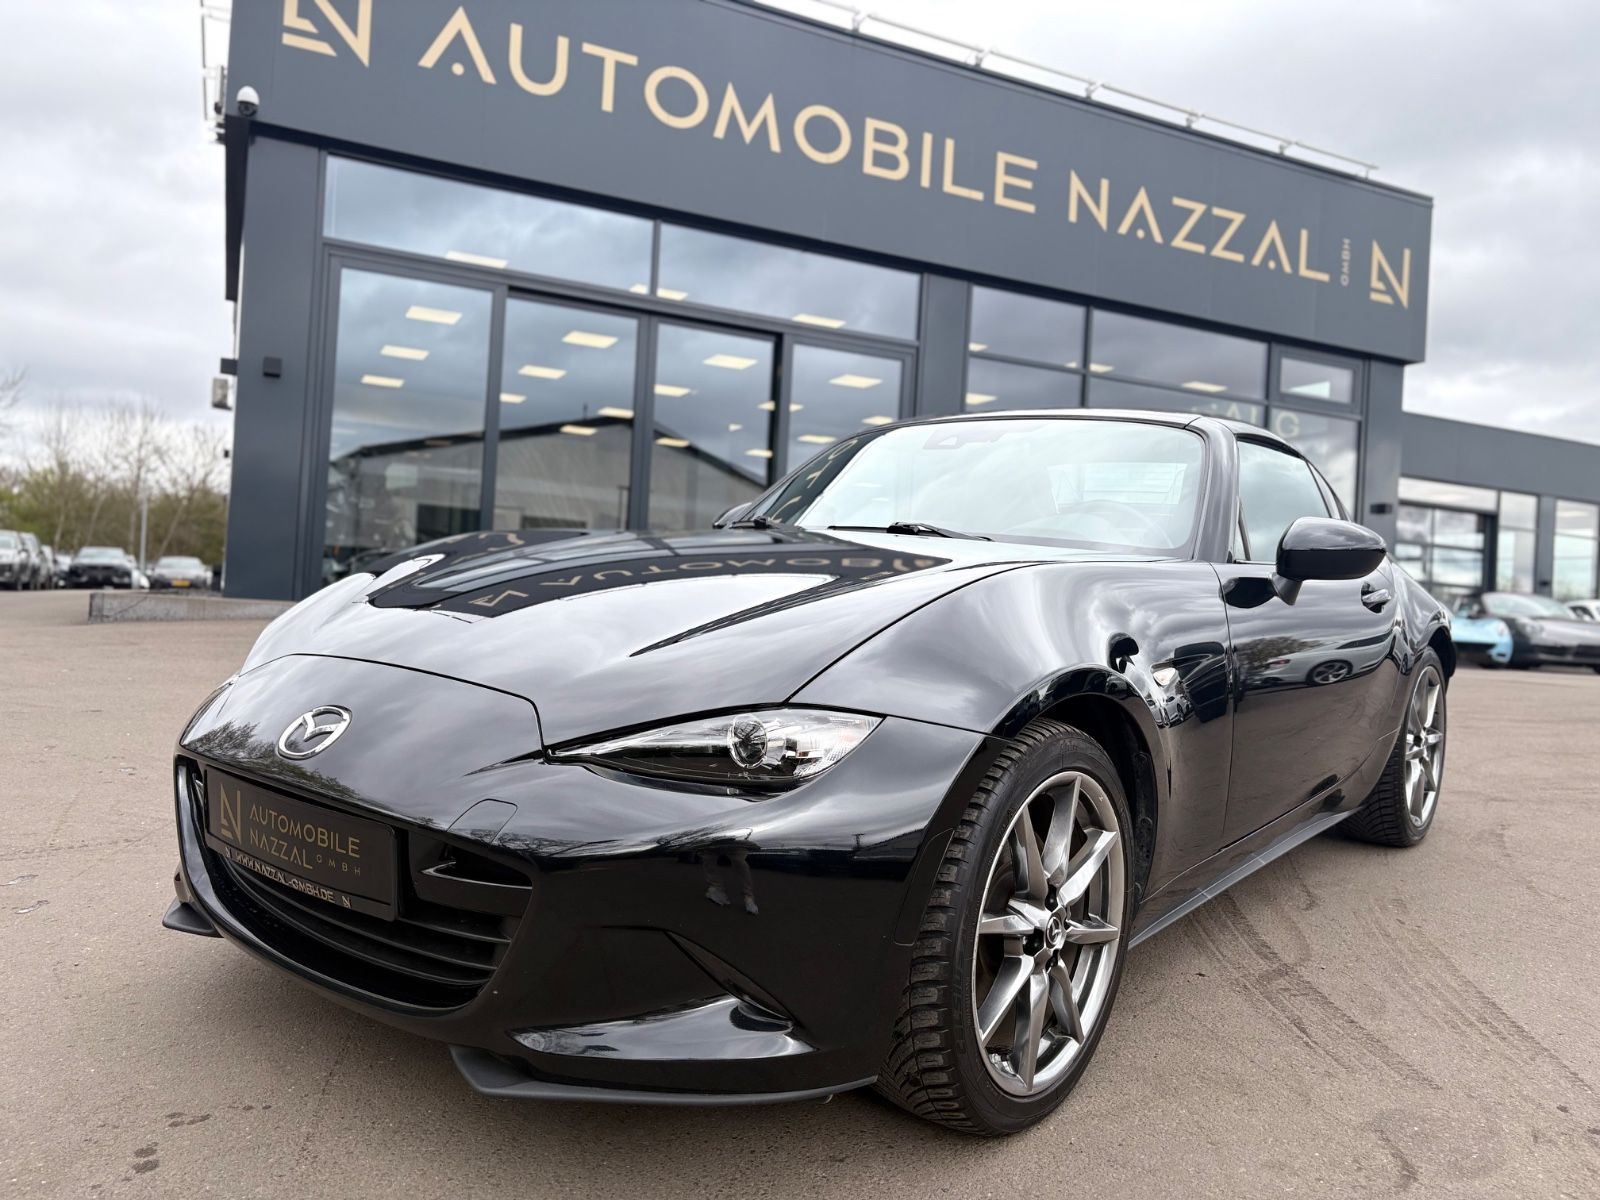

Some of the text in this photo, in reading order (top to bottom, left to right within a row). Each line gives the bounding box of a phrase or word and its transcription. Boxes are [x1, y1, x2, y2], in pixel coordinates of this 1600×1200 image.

[417, 5, 1039, 214] AUTOMOBILE
[1068, 169, 1331, 283] NAZZAL
[249, 803, 361, 859] AUTOMOBILE
[249, 827, 314, 870] NAZZAL
